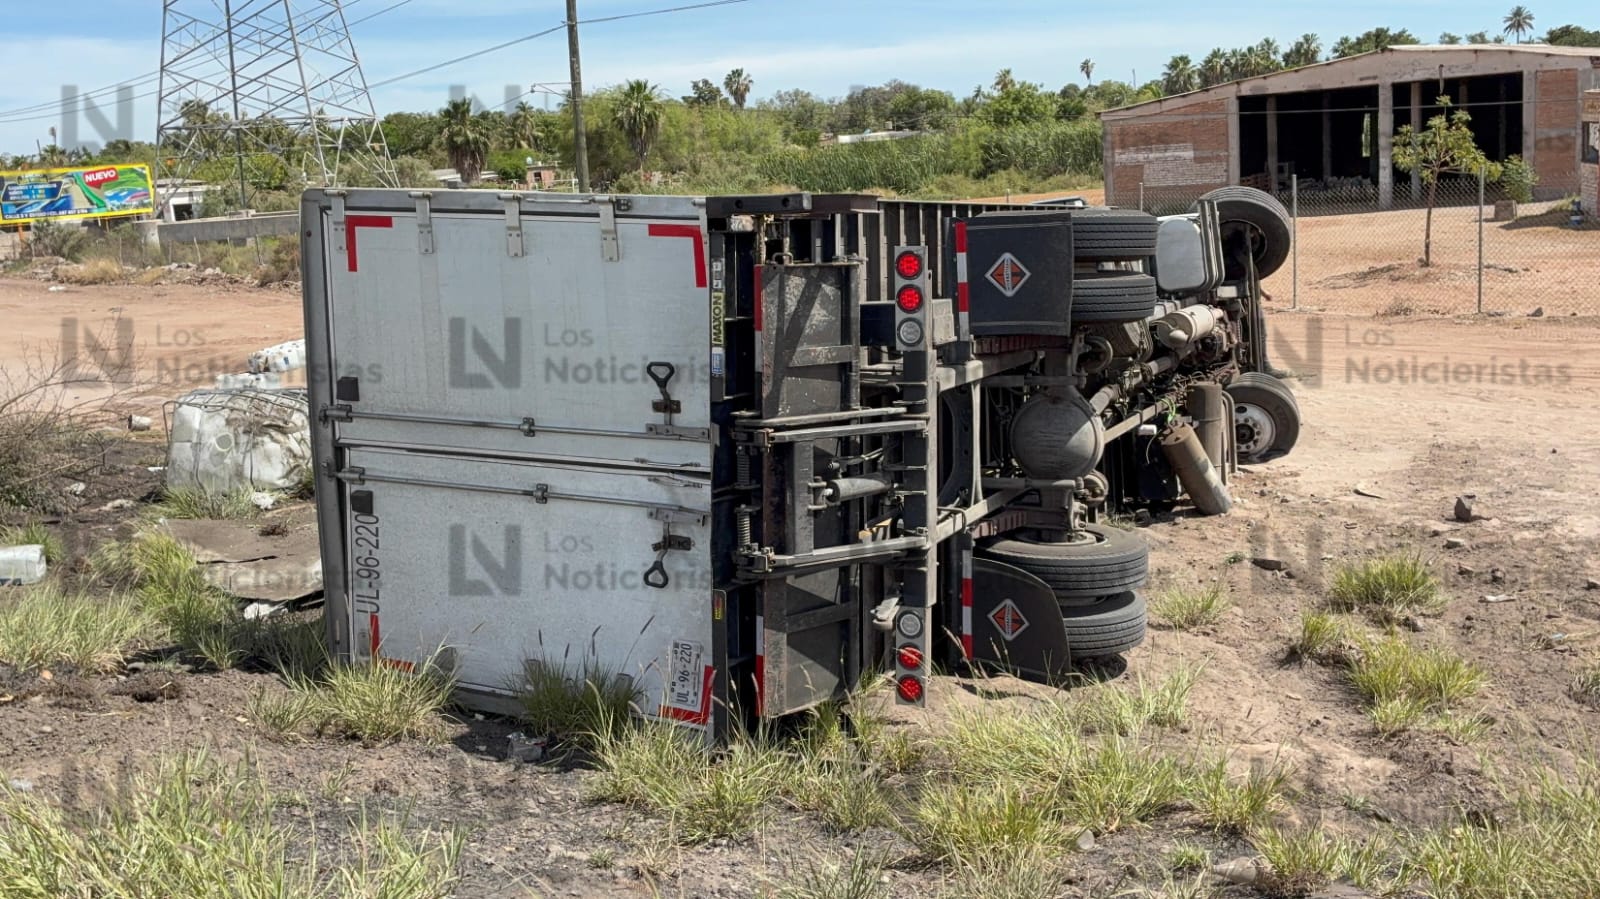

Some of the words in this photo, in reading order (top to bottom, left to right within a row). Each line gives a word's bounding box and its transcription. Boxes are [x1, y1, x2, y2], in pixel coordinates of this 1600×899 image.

[84, 169, 116, 183] NUEVO
[712, 294, 723, 343] MAXON
[354, 513, 380, 614] UL-96-220
[676, 643, 692, 703] UL-96-220
